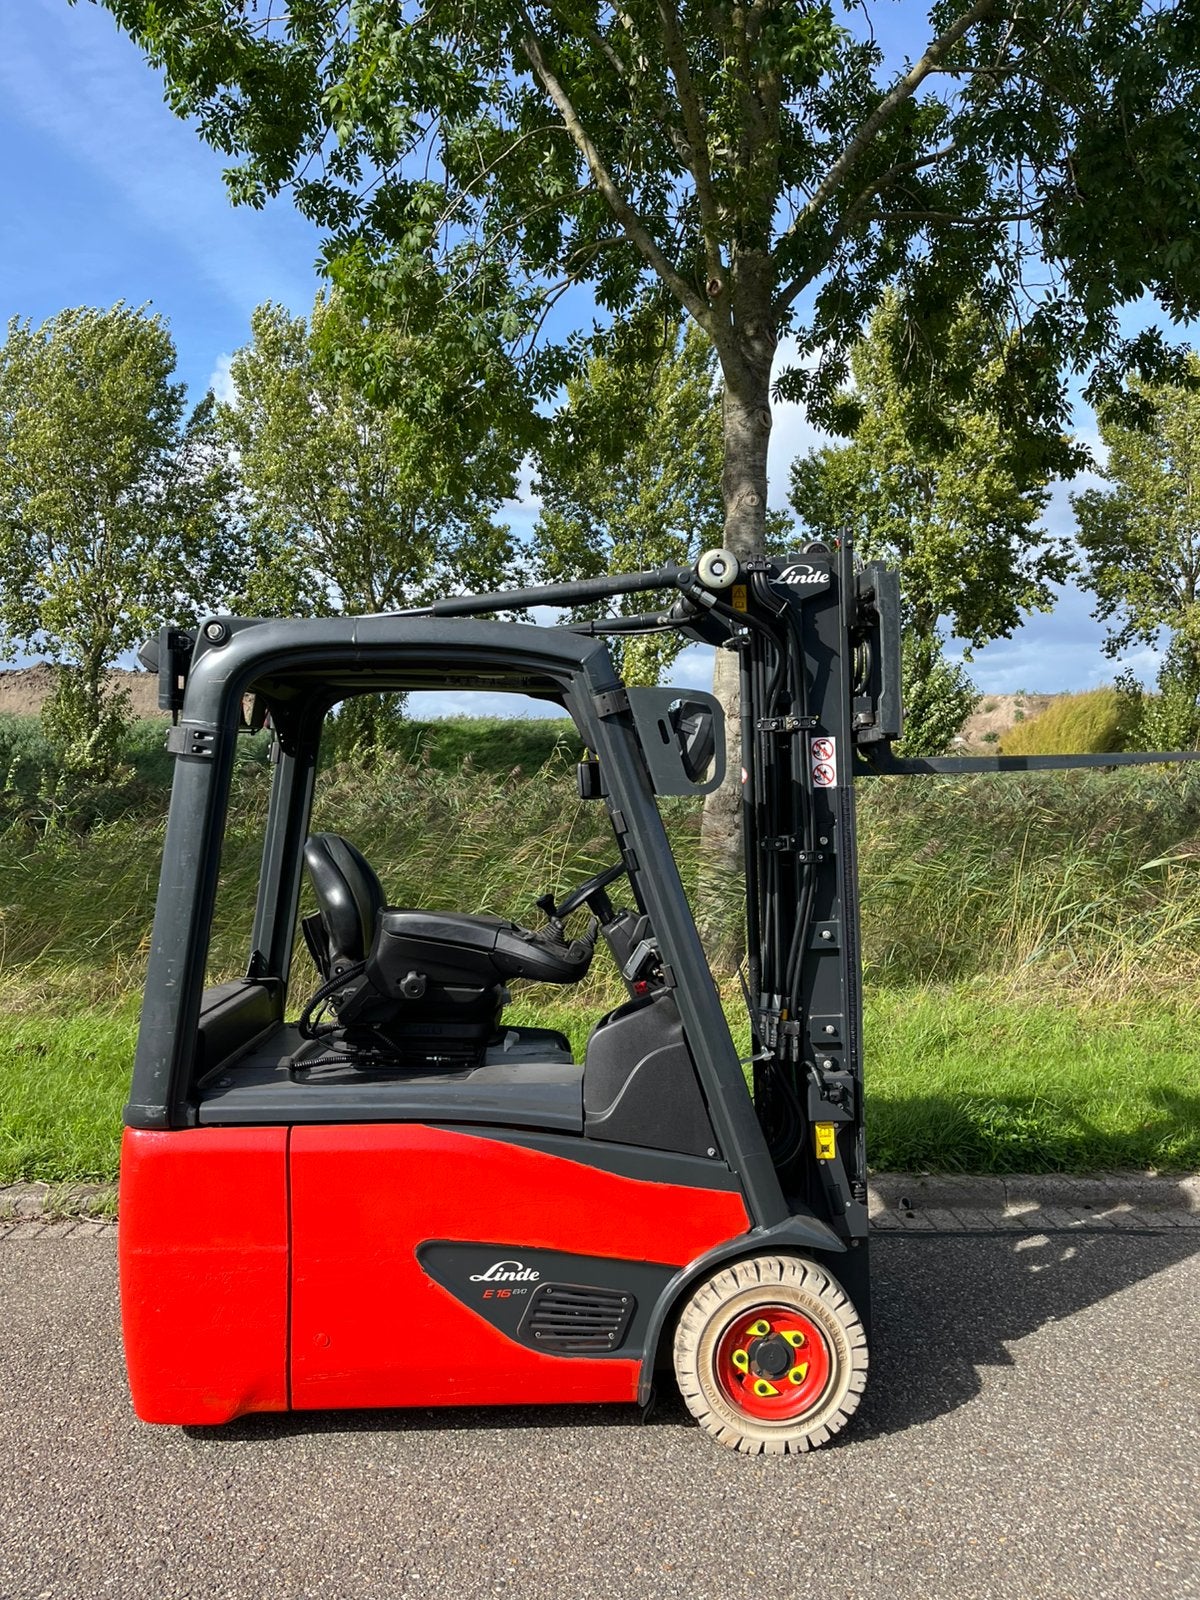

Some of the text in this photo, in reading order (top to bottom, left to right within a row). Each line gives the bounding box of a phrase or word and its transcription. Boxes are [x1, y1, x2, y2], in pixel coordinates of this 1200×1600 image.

[768, 564, 830, 585] Linde
[469, 1260, 540, 1282] Linde
[482, 1289, 496, 1299] E
[496, 1288, 512, 1299] 16
[798, 1293, 848, 1361] TRELLEBORG
